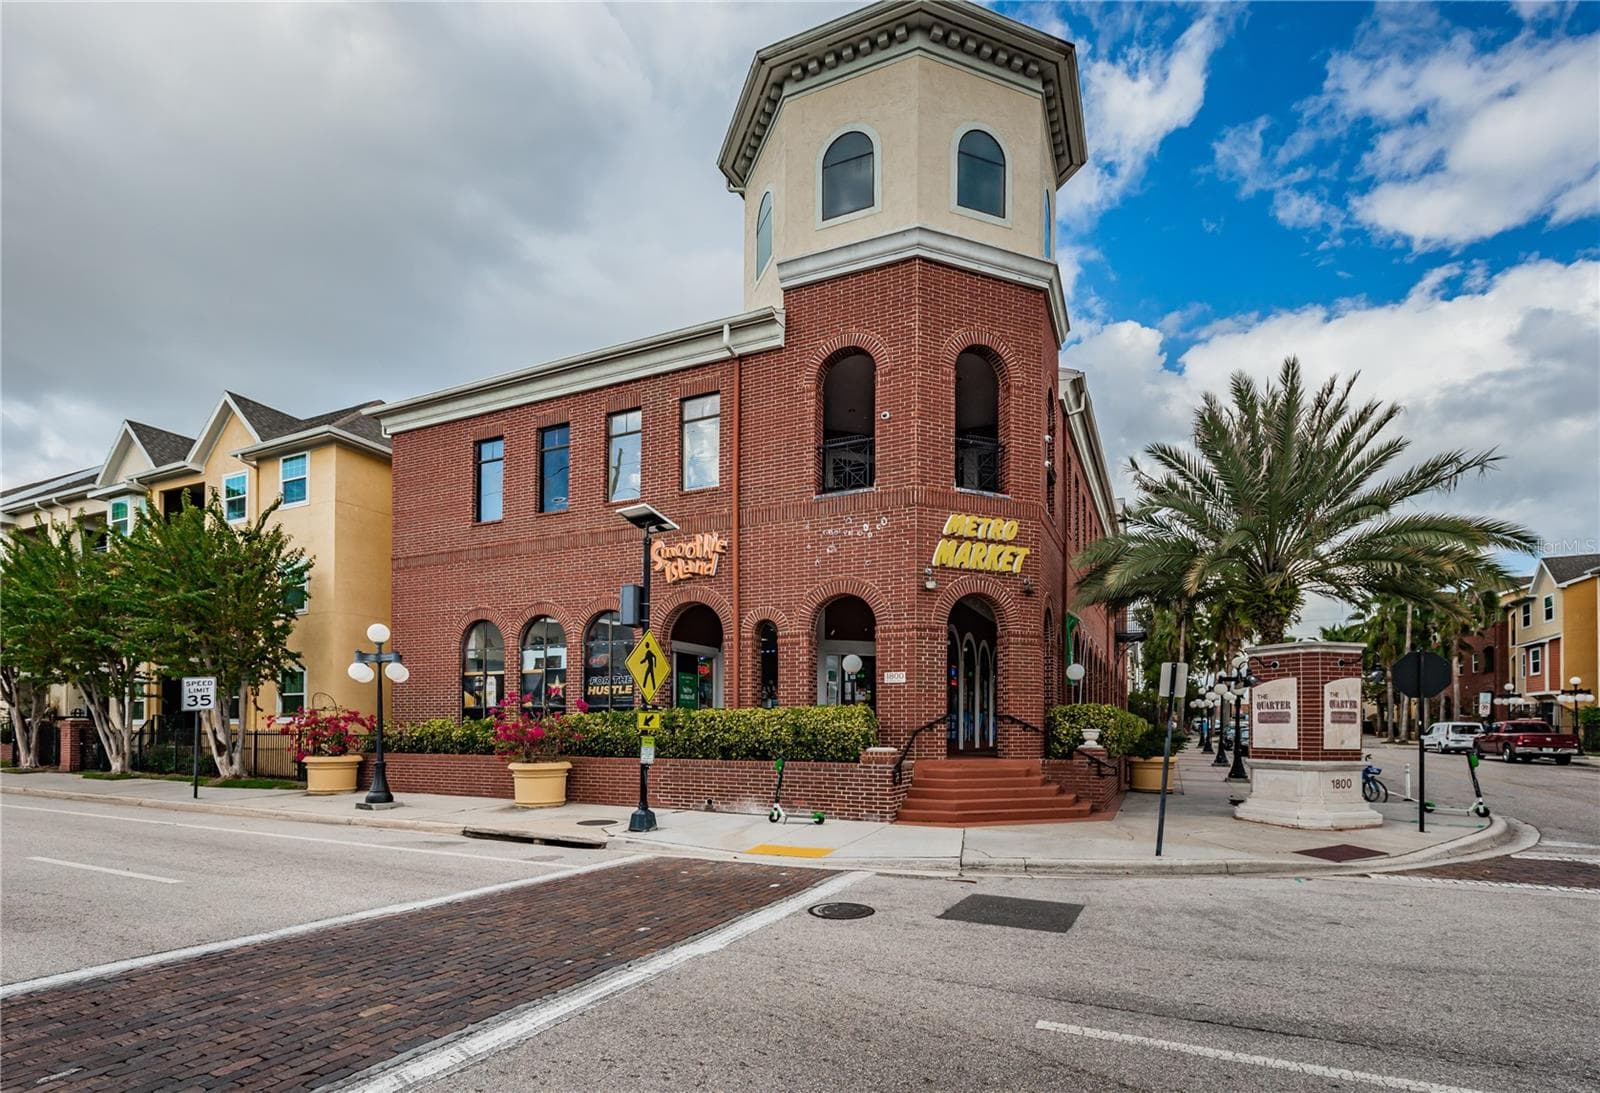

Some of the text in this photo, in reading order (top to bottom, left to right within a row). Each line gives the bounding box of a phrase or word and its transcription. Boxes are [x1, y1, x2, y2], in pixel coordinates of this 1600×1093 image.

[942, 513, 1018, 541] METRO
[932, 537, 1030, 573] MARKET
[590, 674, 633, 685] FOR THE
[886, 672, 904, 680] 1800
[587, 685, 633, 696] HUSTLE
[186, 694, 212, 707] 35
[1256, 700, 1291, 710] QUARTER
[1329, 699, 1357, 709] QUARTER
[1331, 778, 1352, 790] 1800
